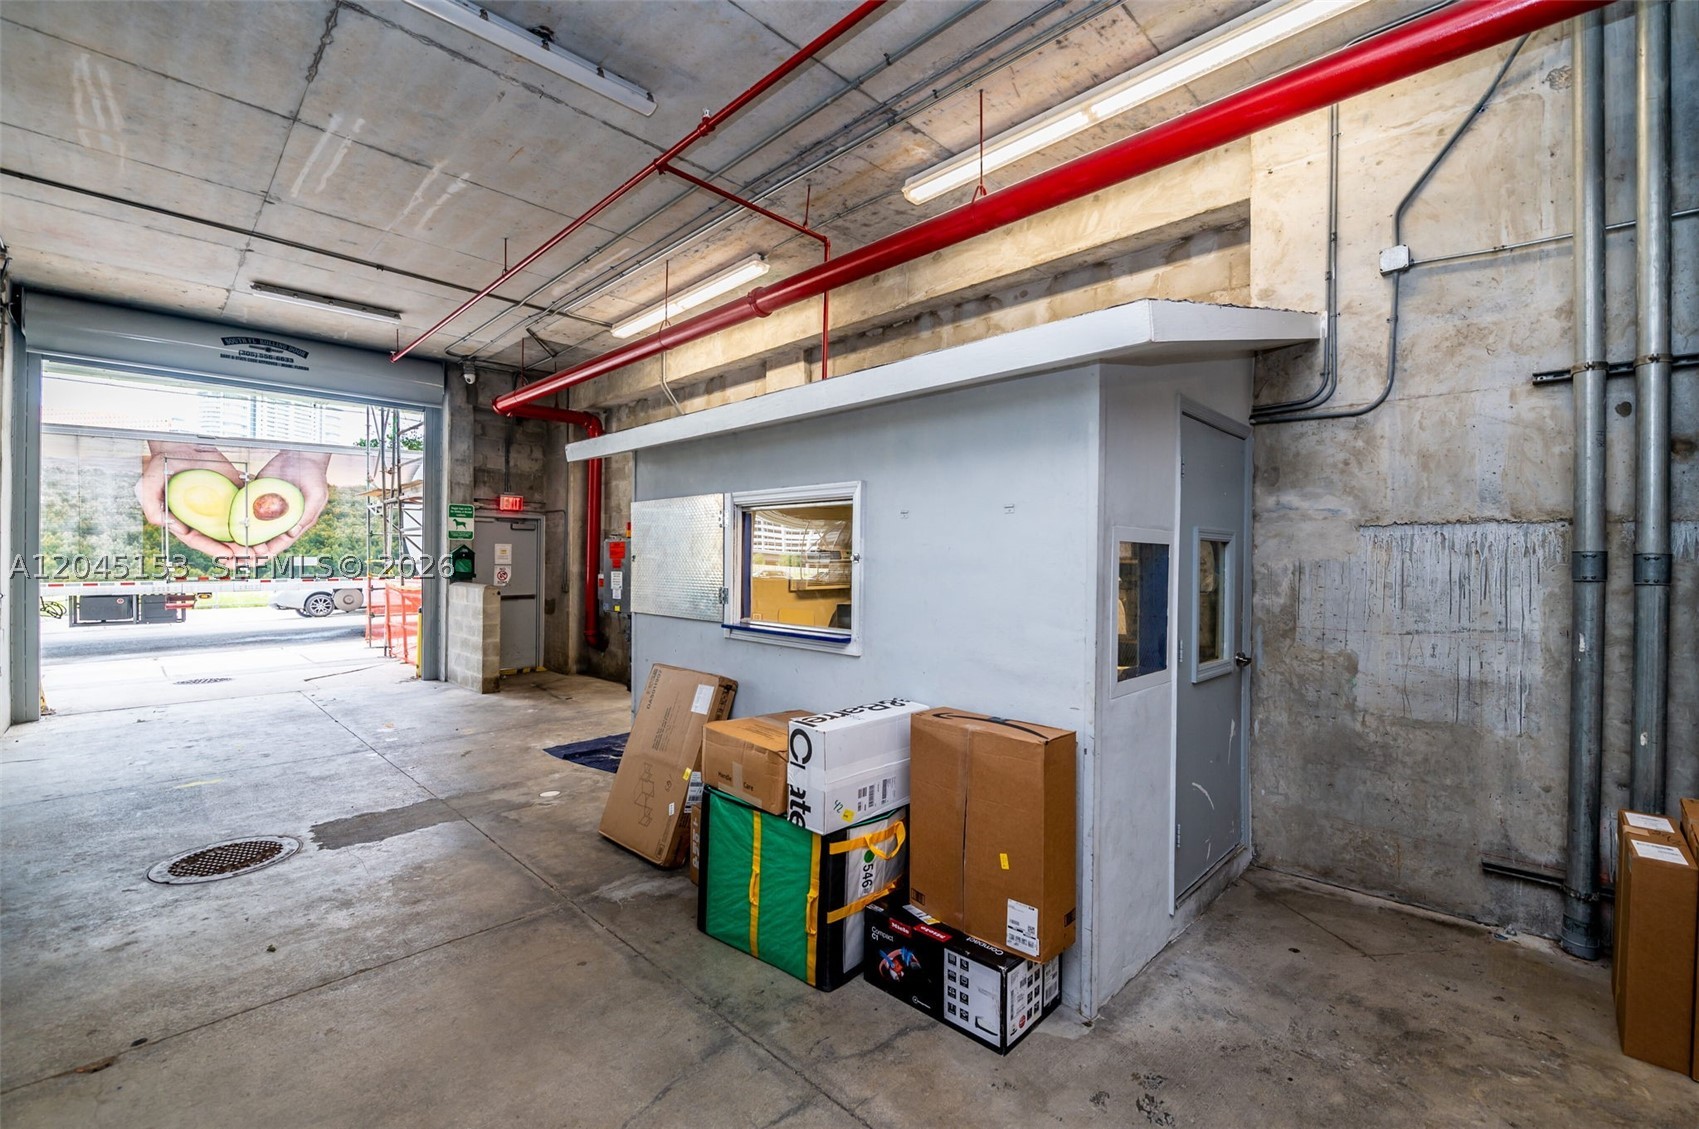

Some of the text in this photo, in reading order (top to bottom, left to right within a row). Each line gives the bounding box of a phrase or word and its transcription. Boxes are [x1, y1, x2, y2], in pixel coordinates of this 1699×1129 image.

[224, 337, 248, 345] SOUTH
[259, 340, 288, 350] ROLLING
[288, 347, 306, 357] DOOR
[238, 350, 258, 358] (305)
[503, 496, 521, 510] EXIT
[743, 781, 755, 792] Care
[833, 799, 844, 814] 42
[861, 863, 874, 888] 546
[871, 926, 894, 942] Compact
[891, 922, 910, 935] Miele
[920, 926, 947, 939] Miele
[871, 932, 879, 941] C1
